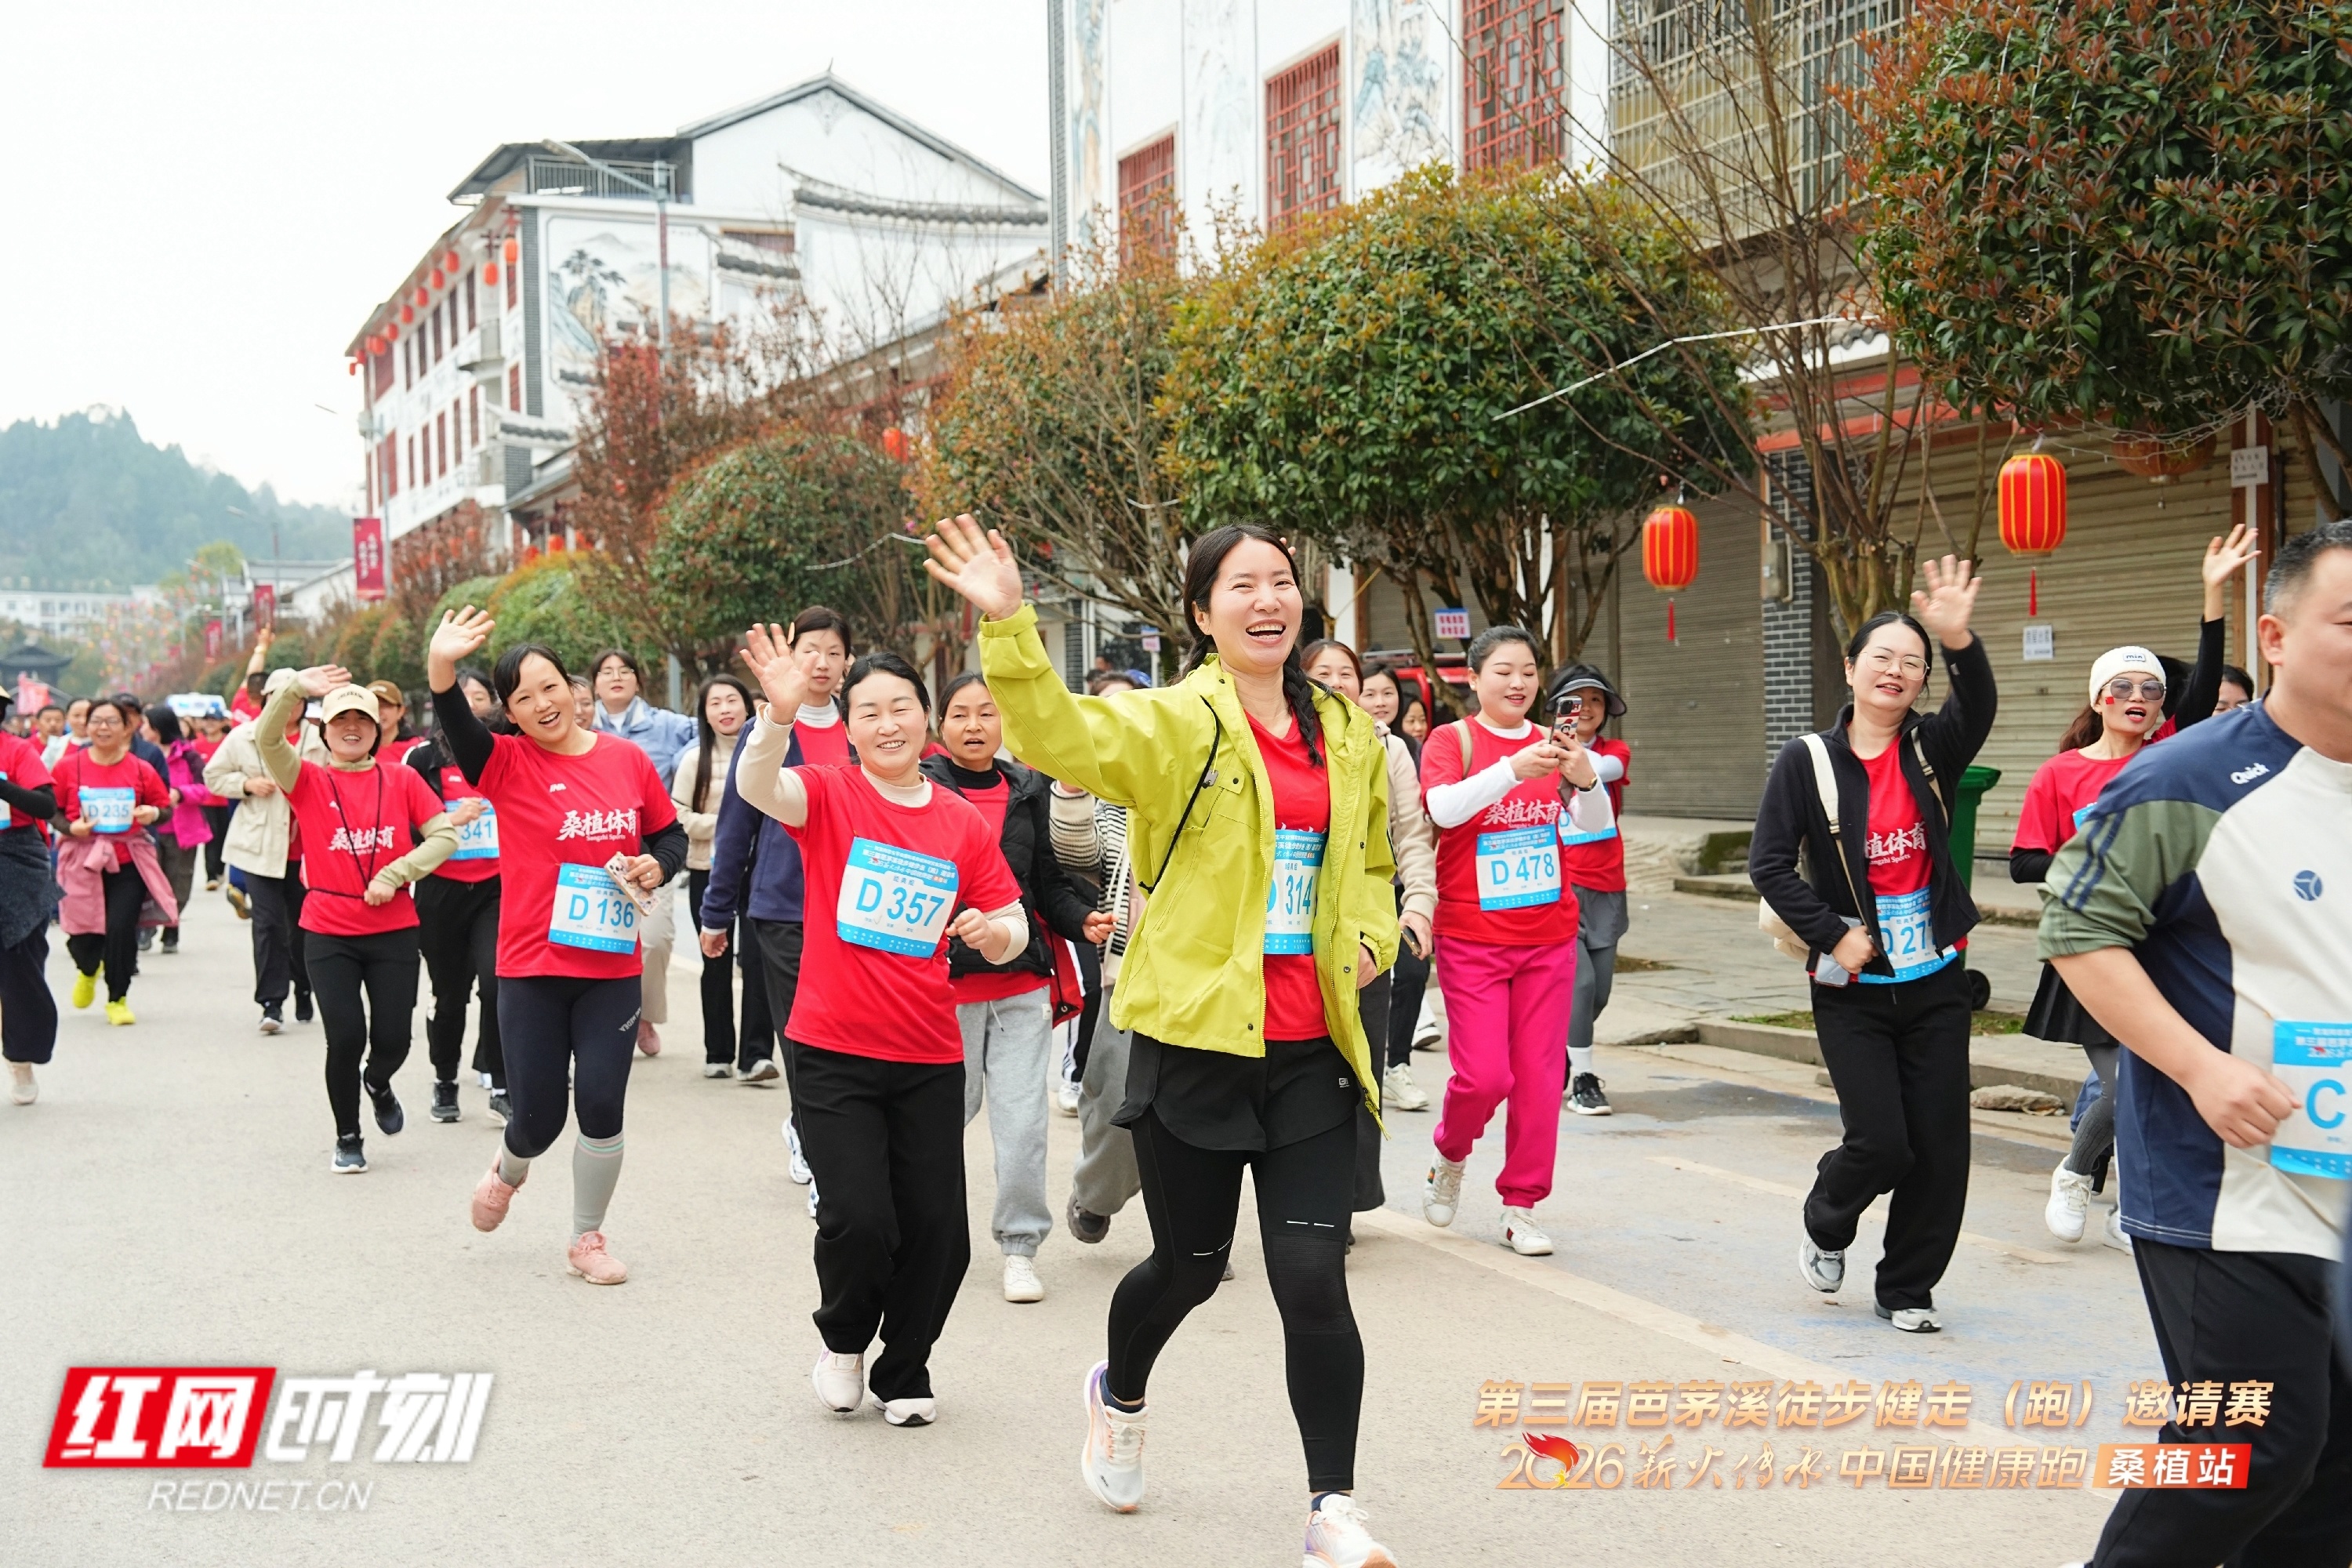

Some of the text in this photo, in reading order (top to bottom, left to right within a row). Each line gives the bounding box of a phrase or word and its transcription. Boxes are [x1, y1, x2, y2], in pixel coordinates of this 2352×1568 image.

[103, 804, 129, 818] 235
[555, 808, 637, 841] 桑植体育
[1482, 797, 1563, 827] 桑植体育
[1490, 852, 1555, 885] D 478
[568, 894, 634, 928] D 136
[856, 877, 883, 913] D
[887, 887, 946, 927] 357
[1285, 874, 1314, 916] 314
[2306, 1079, 2347, 1129] C
